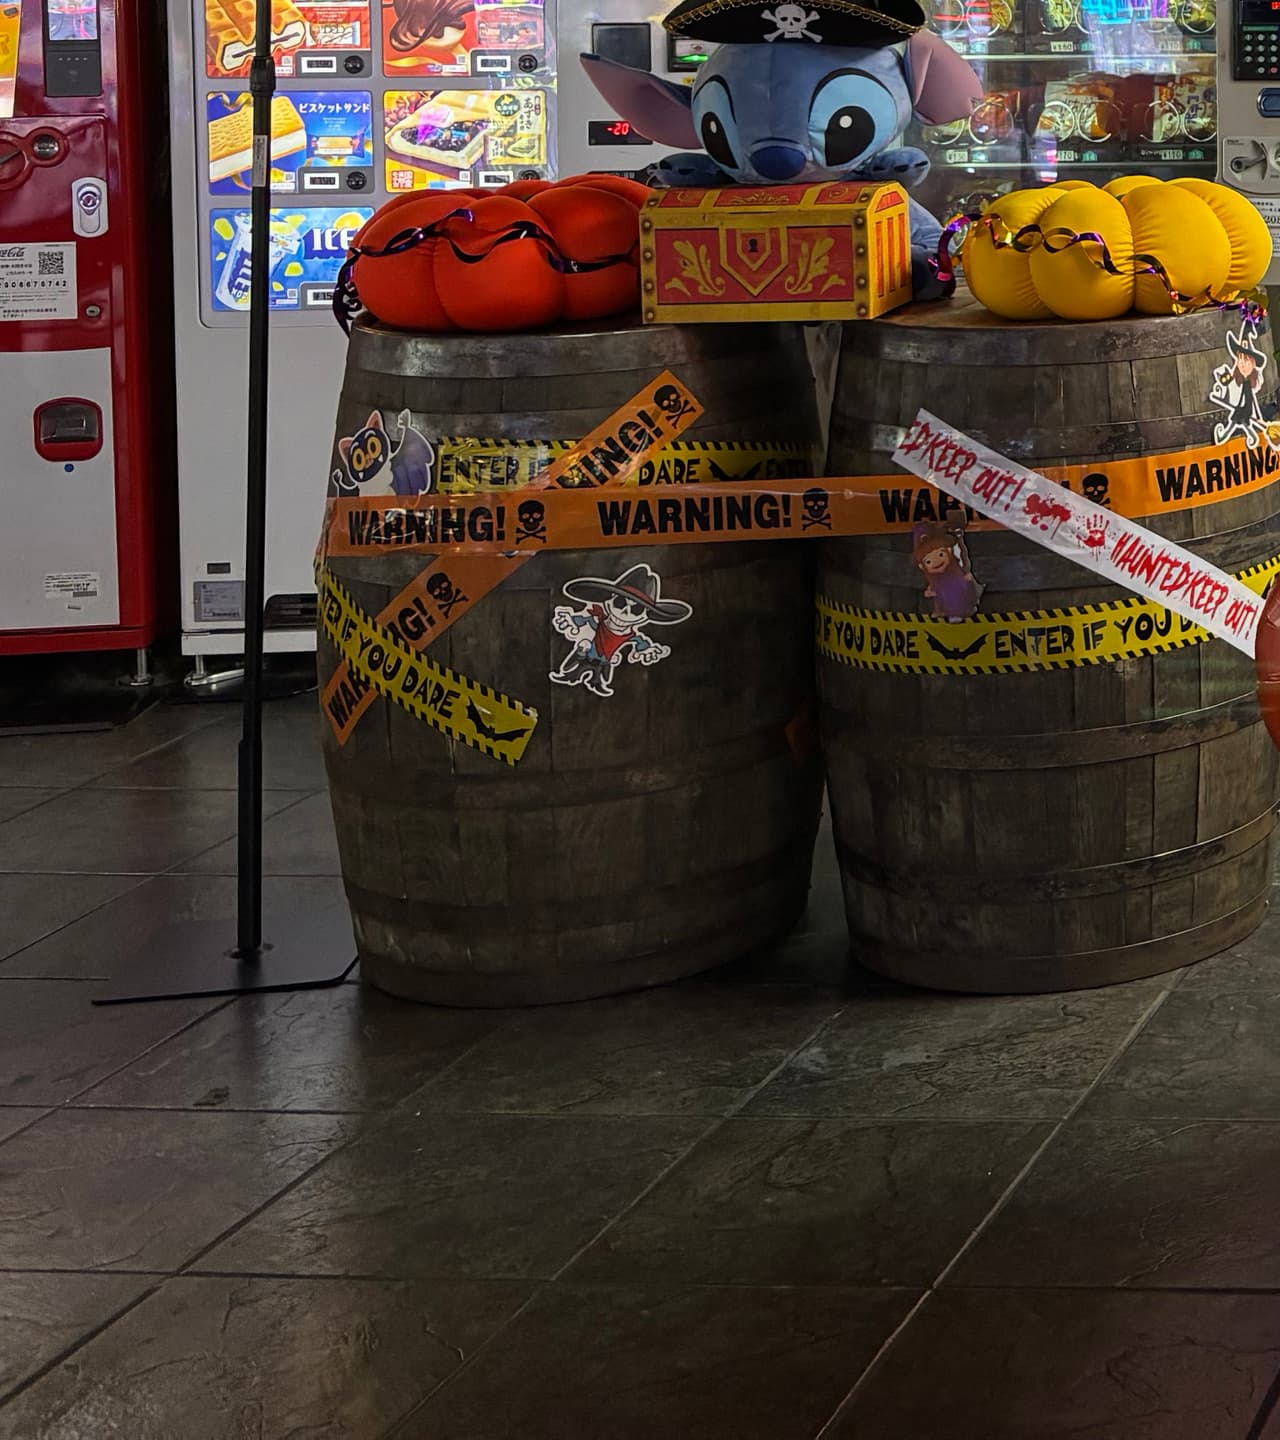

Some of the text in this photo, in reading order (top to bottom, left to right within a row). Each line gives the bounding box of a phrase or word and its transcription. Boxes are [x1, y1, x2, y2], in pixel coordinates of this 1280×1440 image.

[299, 103, 370, 114] ビスケットサンド
[439, 454, 519, 486] ENTER
[638, 458, 701, 486] DARE
[348, 506, 506, 546] WARNING!
[597, 494, 792, 537] WARNING!
[1110, 531, 1192, 598] HAUNTED
[1182, 569, 1230, 622] KEEP
[1223, 598, 1259, 641] OUT!
[834, 620, 866, 653] YOU
[869, 627, 920, 659] DARE
[995, 623, 1076, 659] ENTER
[1082, 618, 1108, 652] IF
[1112, 608, 1172, 645] YOU
[358, 630, 403, 681] YOU
[401, 666, 461, 720] DARE
